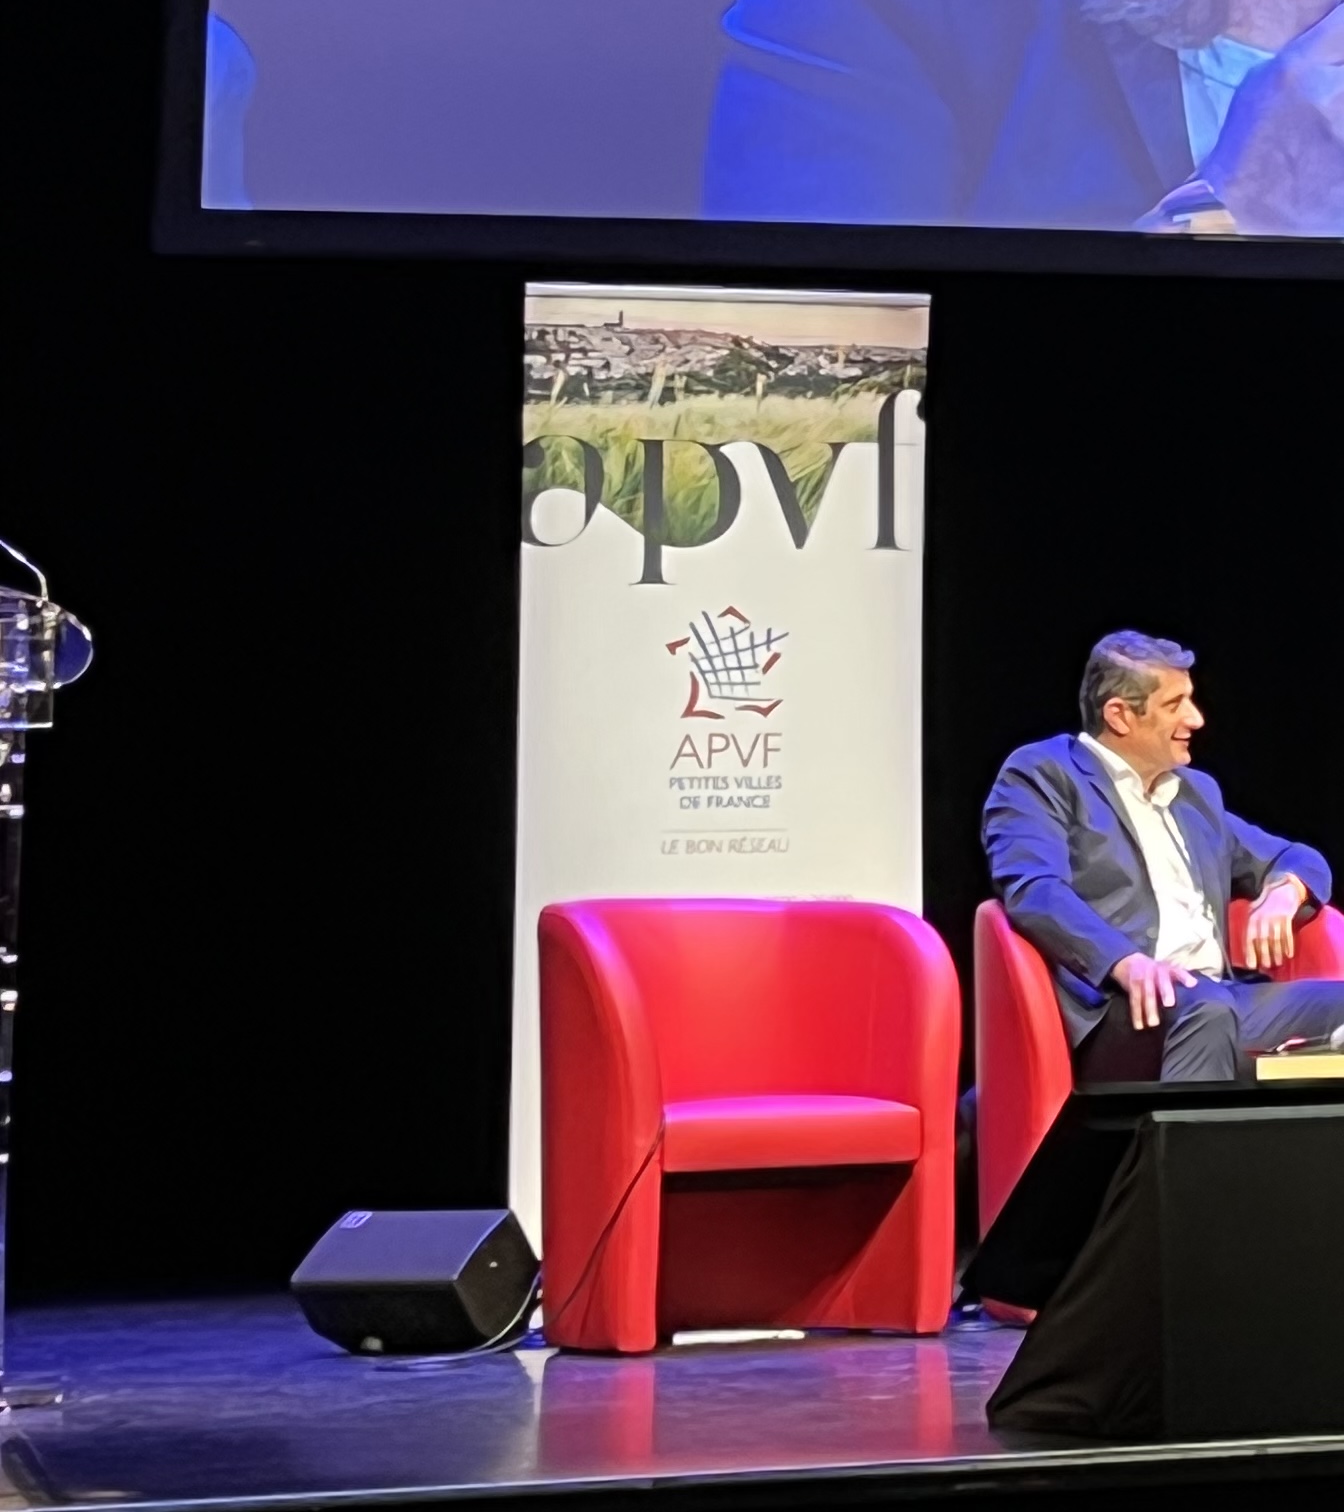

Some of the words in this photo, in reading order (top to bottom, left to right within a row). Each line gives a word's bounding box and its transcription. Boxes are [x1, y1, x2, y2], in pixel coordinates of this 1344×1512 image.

[521, 388, 926, 586] apvf
[669, 732, 783, 770] APVF
[668, 775, 730, 790] PETITES
[733, 774, 783, 790] VILLES
[679, 795, 701, 809] DE
[706, 794, 771, 809] FRANCE
[660, 838, 679, 855] LE
[685, 838, 723, 854] BON
[727, 834, 790, 855] RÉSEAU
